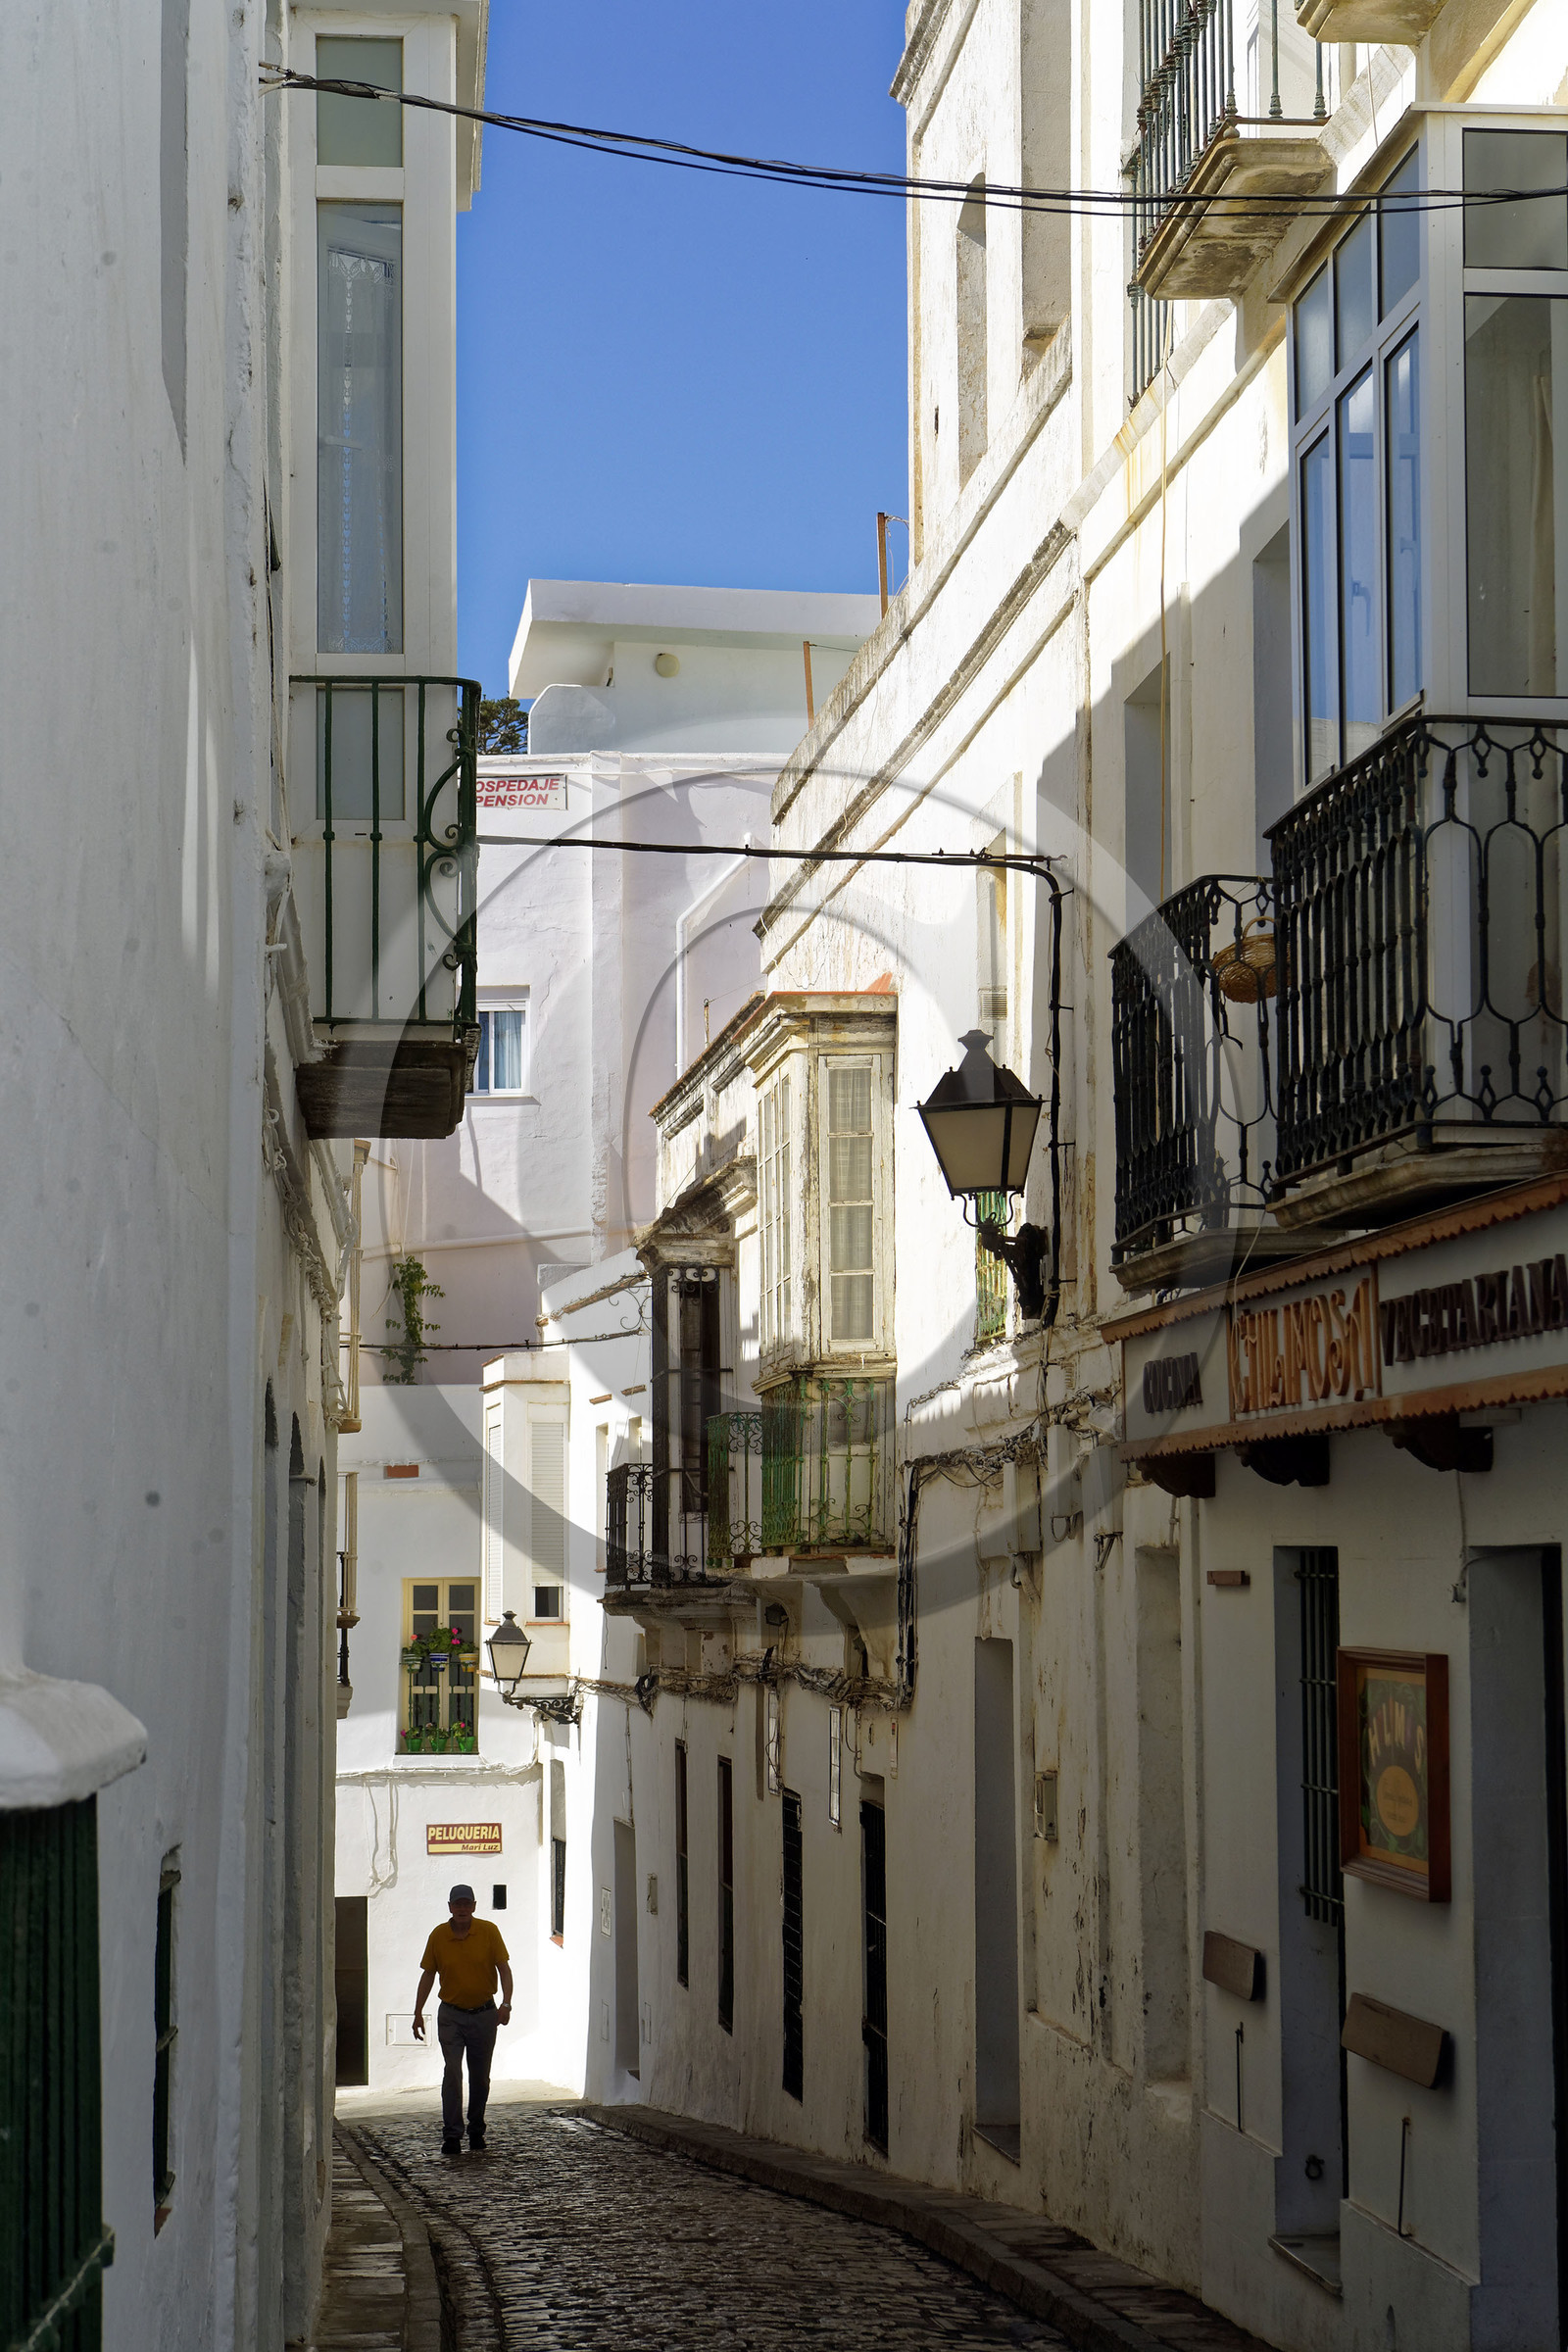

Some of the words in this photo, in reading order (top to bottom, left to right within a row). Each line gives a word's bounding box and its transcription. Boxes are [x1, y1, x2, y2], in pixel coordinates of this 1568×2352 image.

[476, 778, 560, 793] OSPEDAJE
[1143, 1351, 1203, 1414] COCINA
[1378, 1253, 1568, 1367] VEGETARIANA
[428, 1825, 500, 1840] PELUQUERIA
